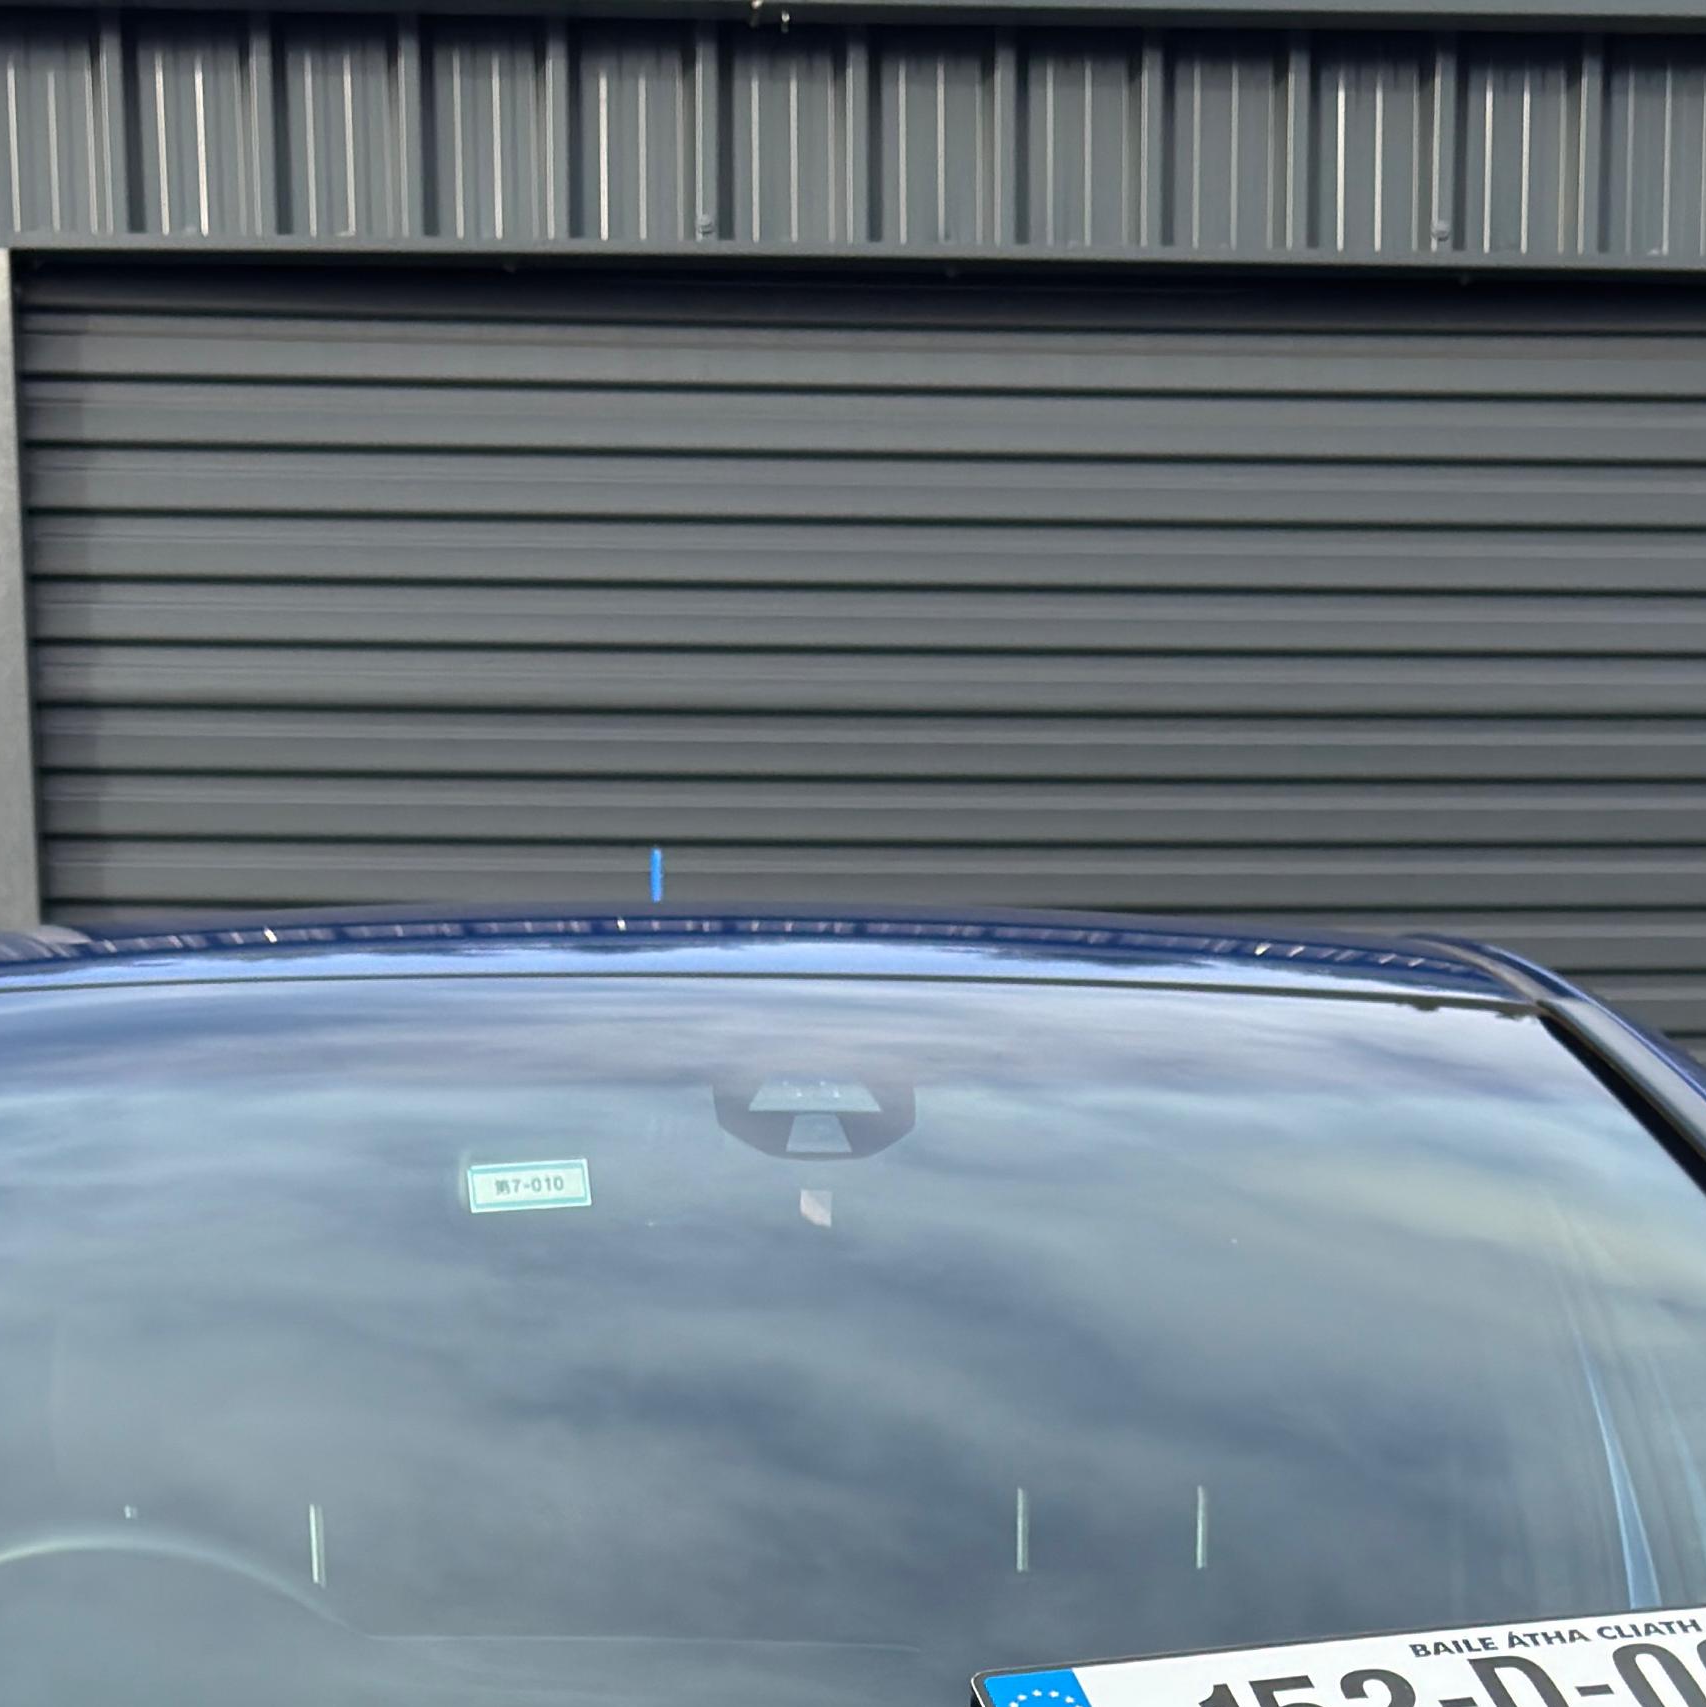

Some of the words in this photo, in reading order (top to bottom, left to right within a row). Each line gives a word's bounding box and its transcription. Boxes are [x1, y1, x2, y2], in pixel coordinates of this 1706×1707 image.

[1408, 1636, 1500, 1658] BAILE
[1507, 1629, 1592, 1650] ÁTHA
[1596, 1618, 1703, 1641] CLIATH
